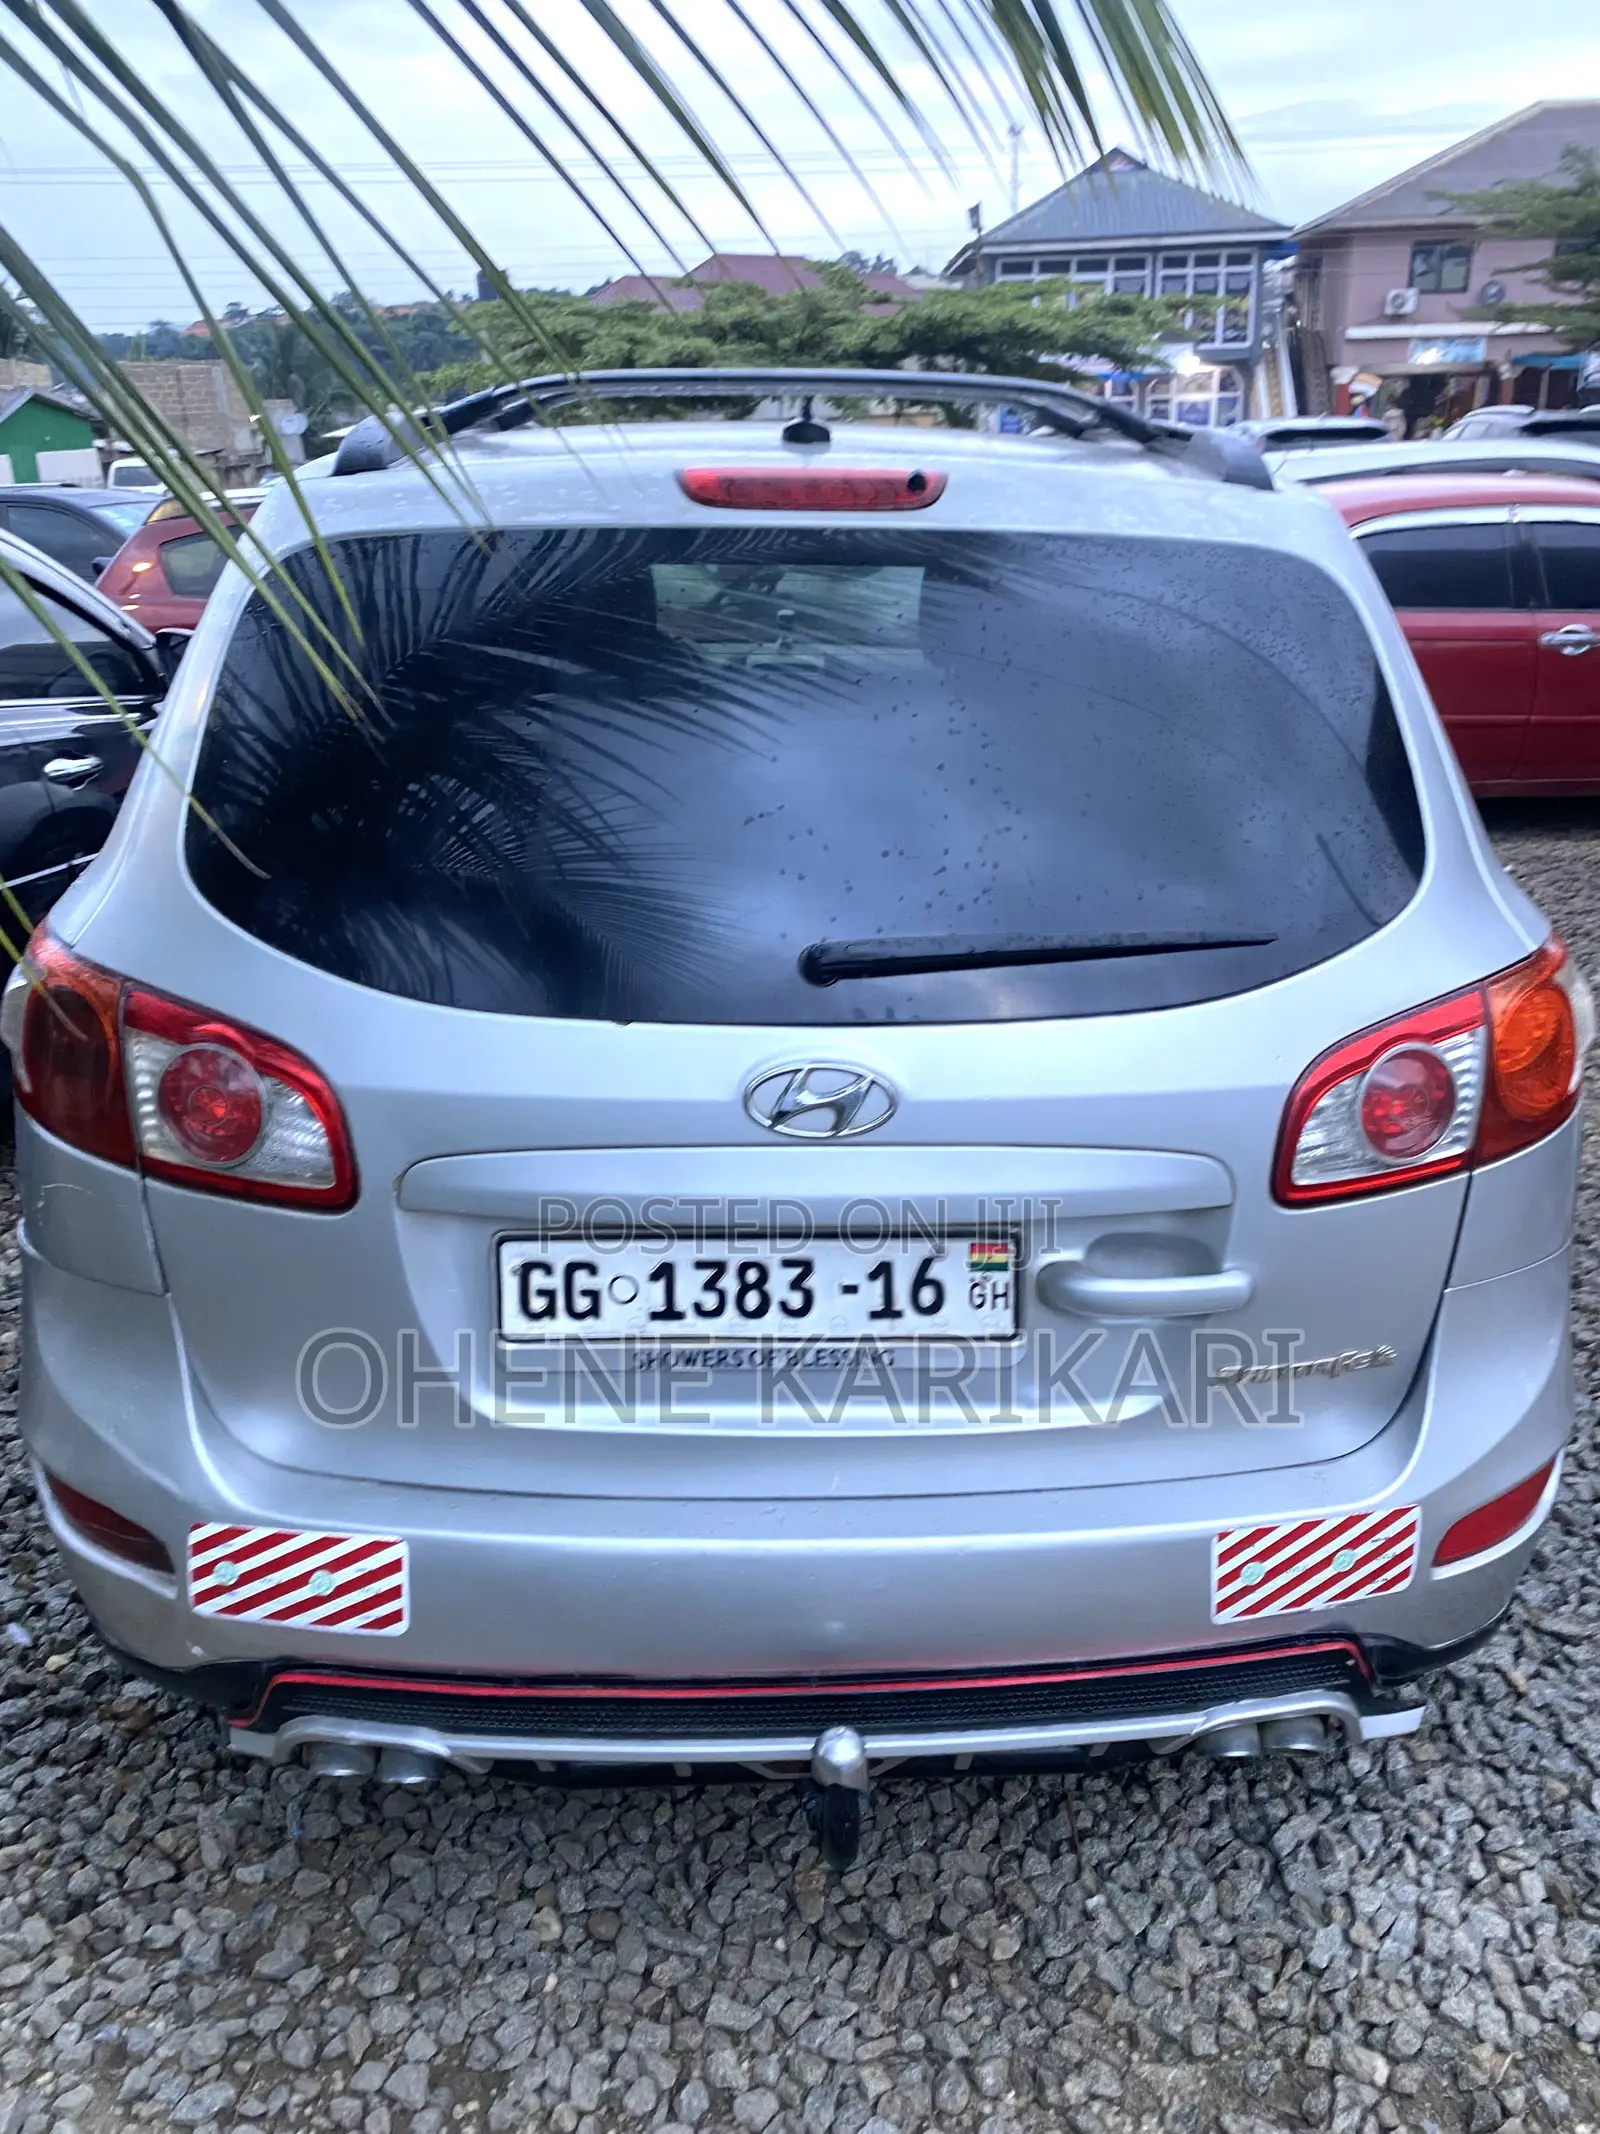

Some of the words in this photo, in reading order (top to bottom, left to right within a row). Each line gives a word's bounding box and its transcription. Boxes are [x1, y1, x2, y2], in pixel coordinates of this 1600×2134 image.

[518, 1260, 601, 1321] GG
[648, 1257, 816, 1321] 1383
[968, 1280, 1010, 1310] GH
[631, 1347, 744, 1370] SHOWERS
[782, 1347, 896, 1367] BLESSING
